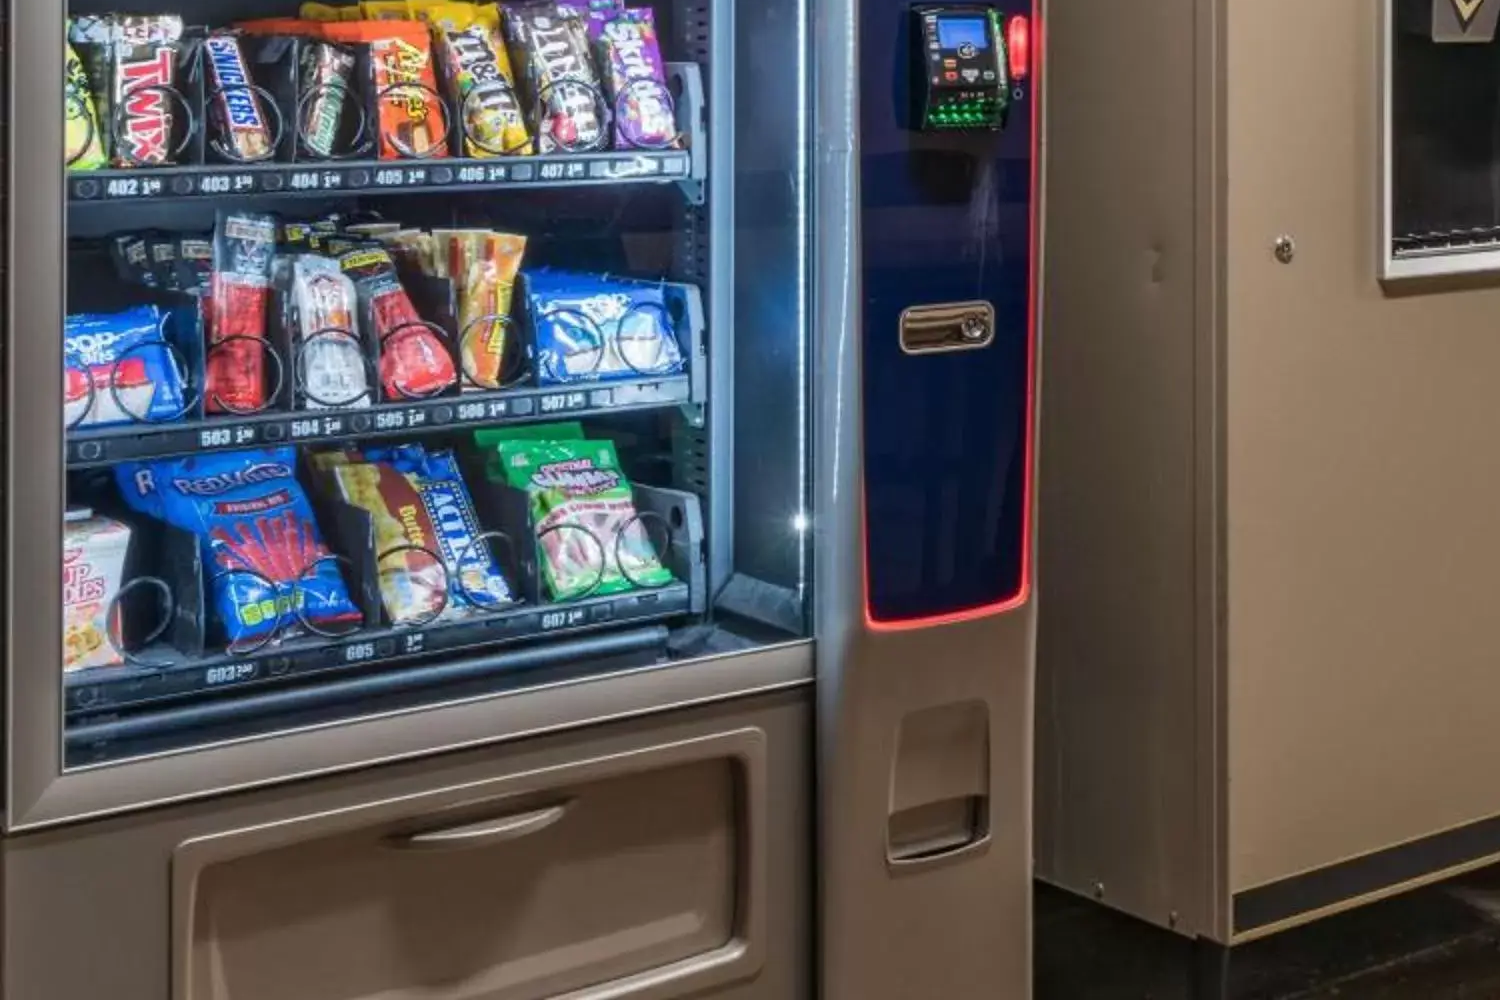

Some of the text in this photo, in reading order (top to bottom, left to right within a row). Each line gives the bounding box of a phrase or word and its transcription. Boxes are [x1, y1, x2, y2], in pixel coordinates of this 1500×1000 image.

[208, 39, 260, 128] SNICKERS
[119, 47, 172, 161] TWIX
[376, 169, 403, 185] 405
[458, 167, 485, 181] 406
[541, 164, 565, 178] 407
[107, 179, 139, 196] 402
[201, 176, 230, 192] 403
[291, 172, 319, 188] 404
[376, 411, 405, 428] 505
[291, 420, 319, 437] 504
[201, 429, 231, 446] 503
[346, 644, 374, 660] 605
[206, 665, 235, 684] 603
